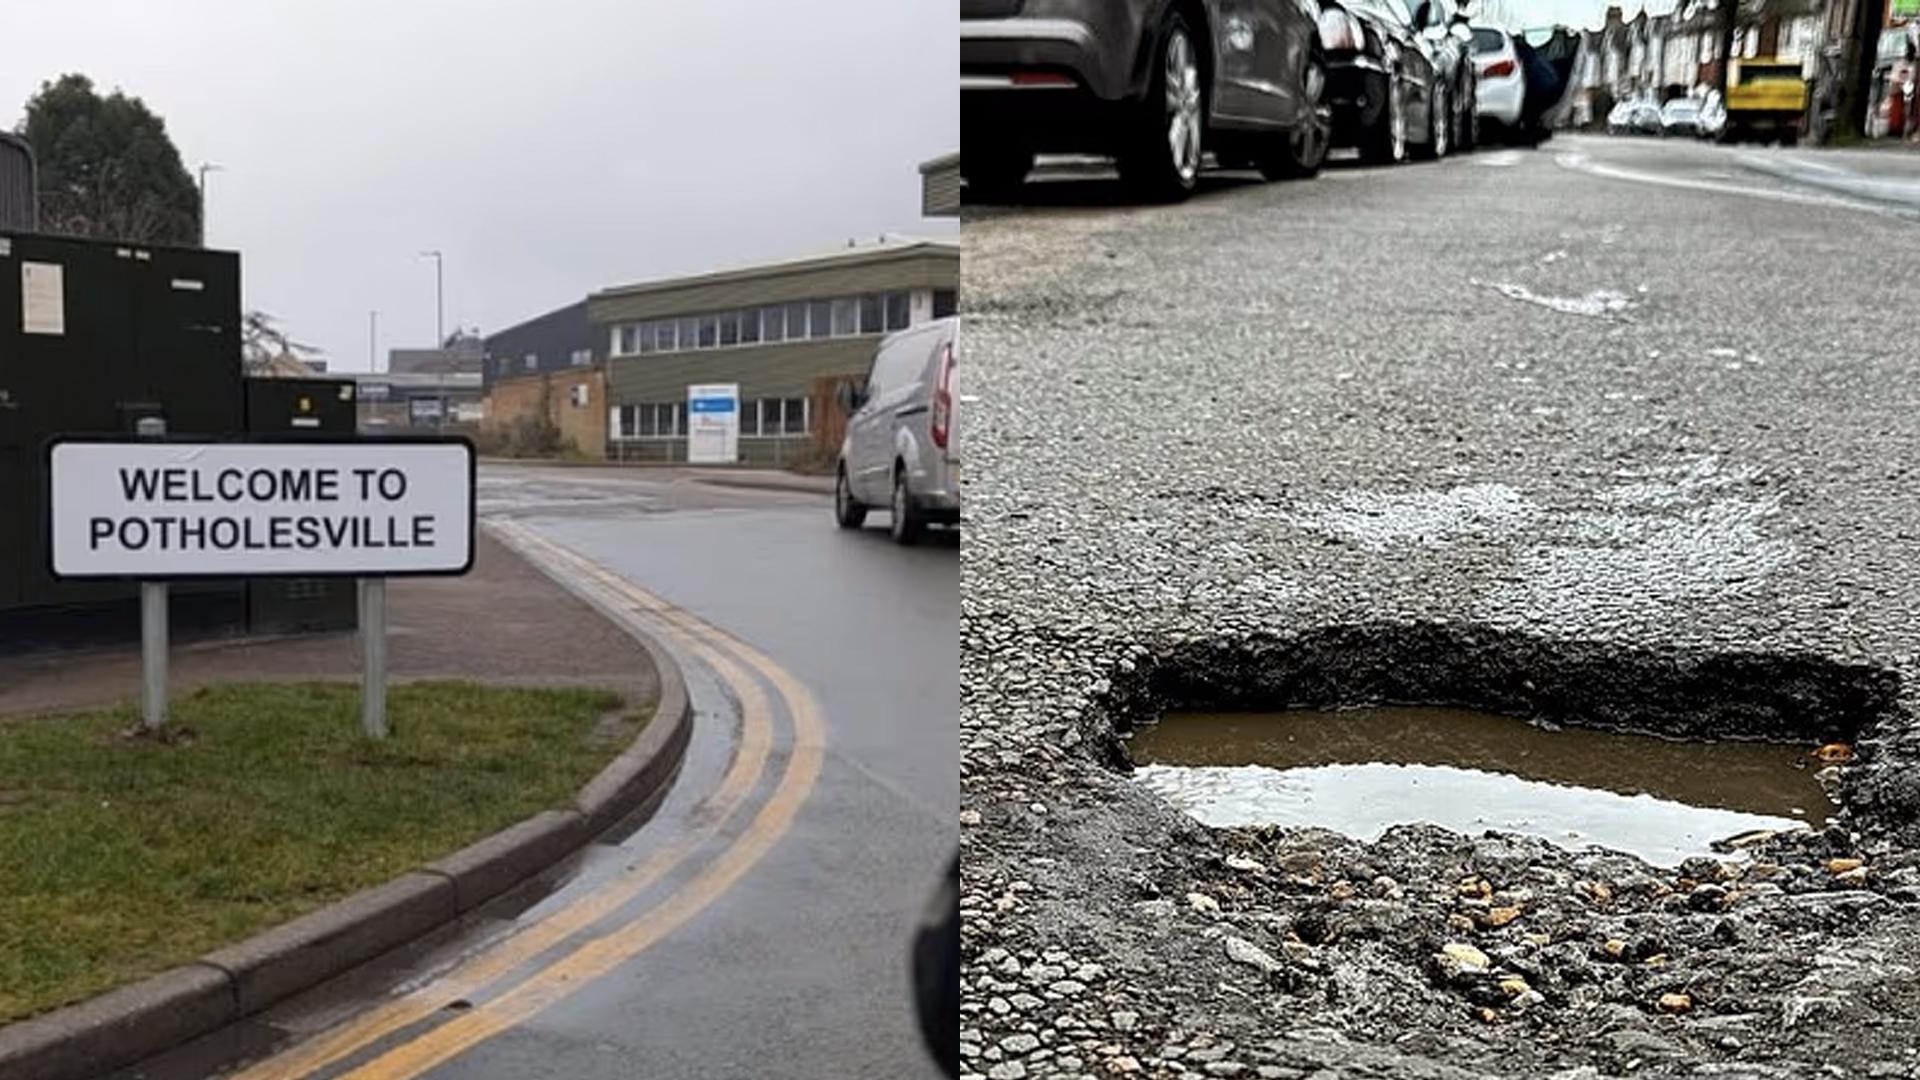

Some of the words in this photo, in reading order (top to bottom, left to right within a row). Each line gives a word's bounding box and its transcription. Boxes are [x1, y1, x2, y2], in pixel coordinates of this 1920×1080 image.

[119, 468, 339, 501] WELCOME
[352, 468, 407, 501] TO
[89, 515, 436, 550] POTHOLESVILLE
